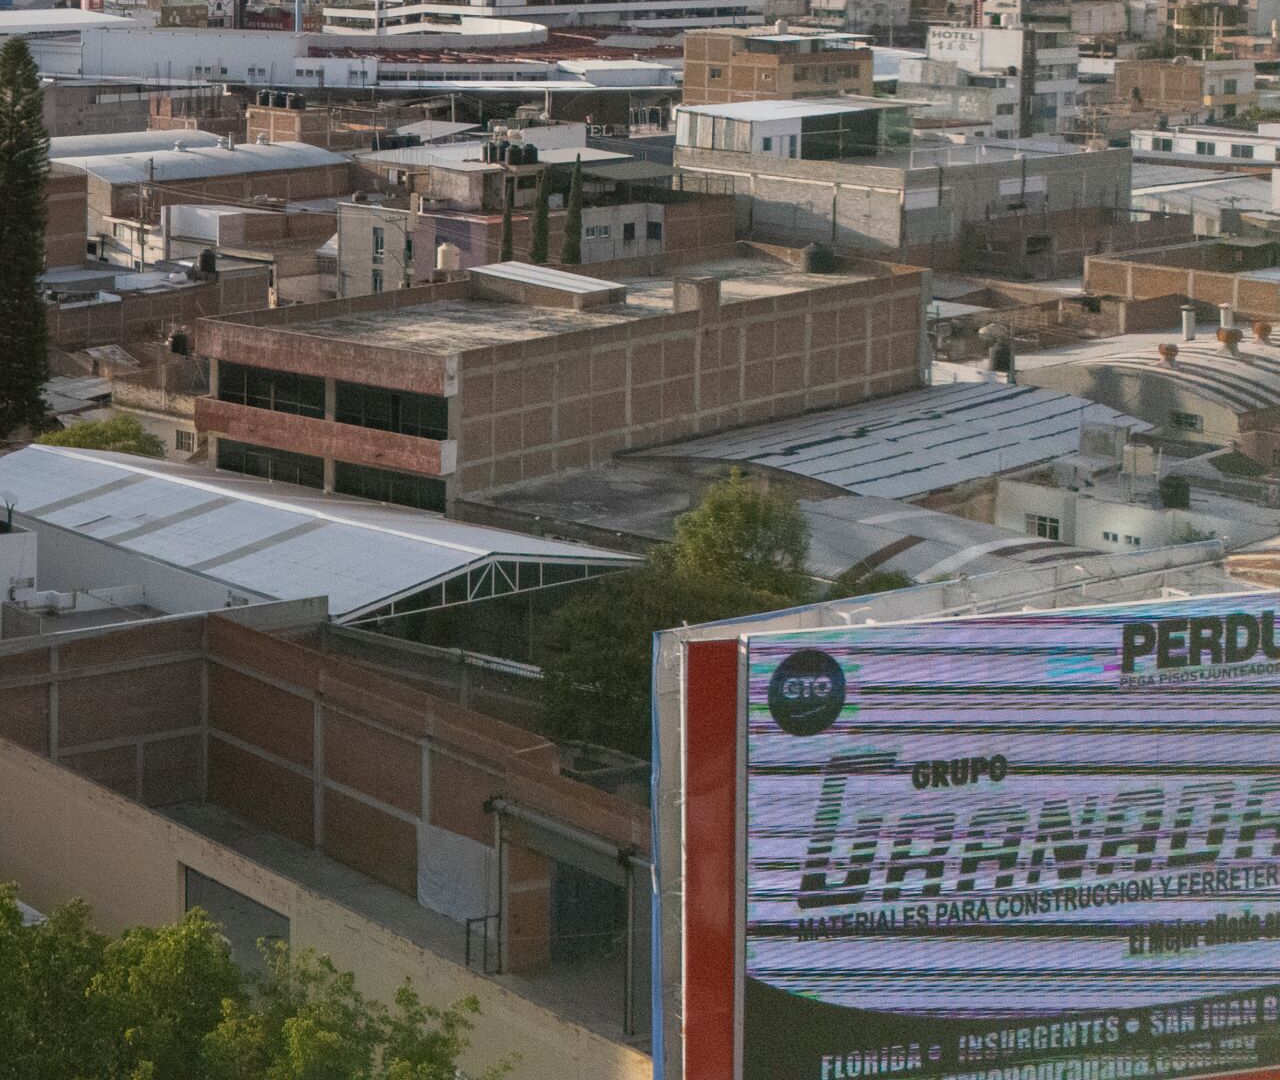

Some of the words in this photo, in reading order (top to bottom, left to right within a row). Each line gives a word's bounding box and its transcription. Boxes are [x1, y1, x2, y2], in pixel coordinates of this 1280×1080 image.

[932, 31, 976, 40] HOTEL
[912, 754, 1007, 790] GRUPO
[798, 904, 929, 942] MATERIALES
[936, 898, 990, 926] PARA
[995, 876, 1154, 919] CONSTRUCCION
[1160, 876, 1172, 894] Y
[1151, 1007, 1196, 1035] SAN
